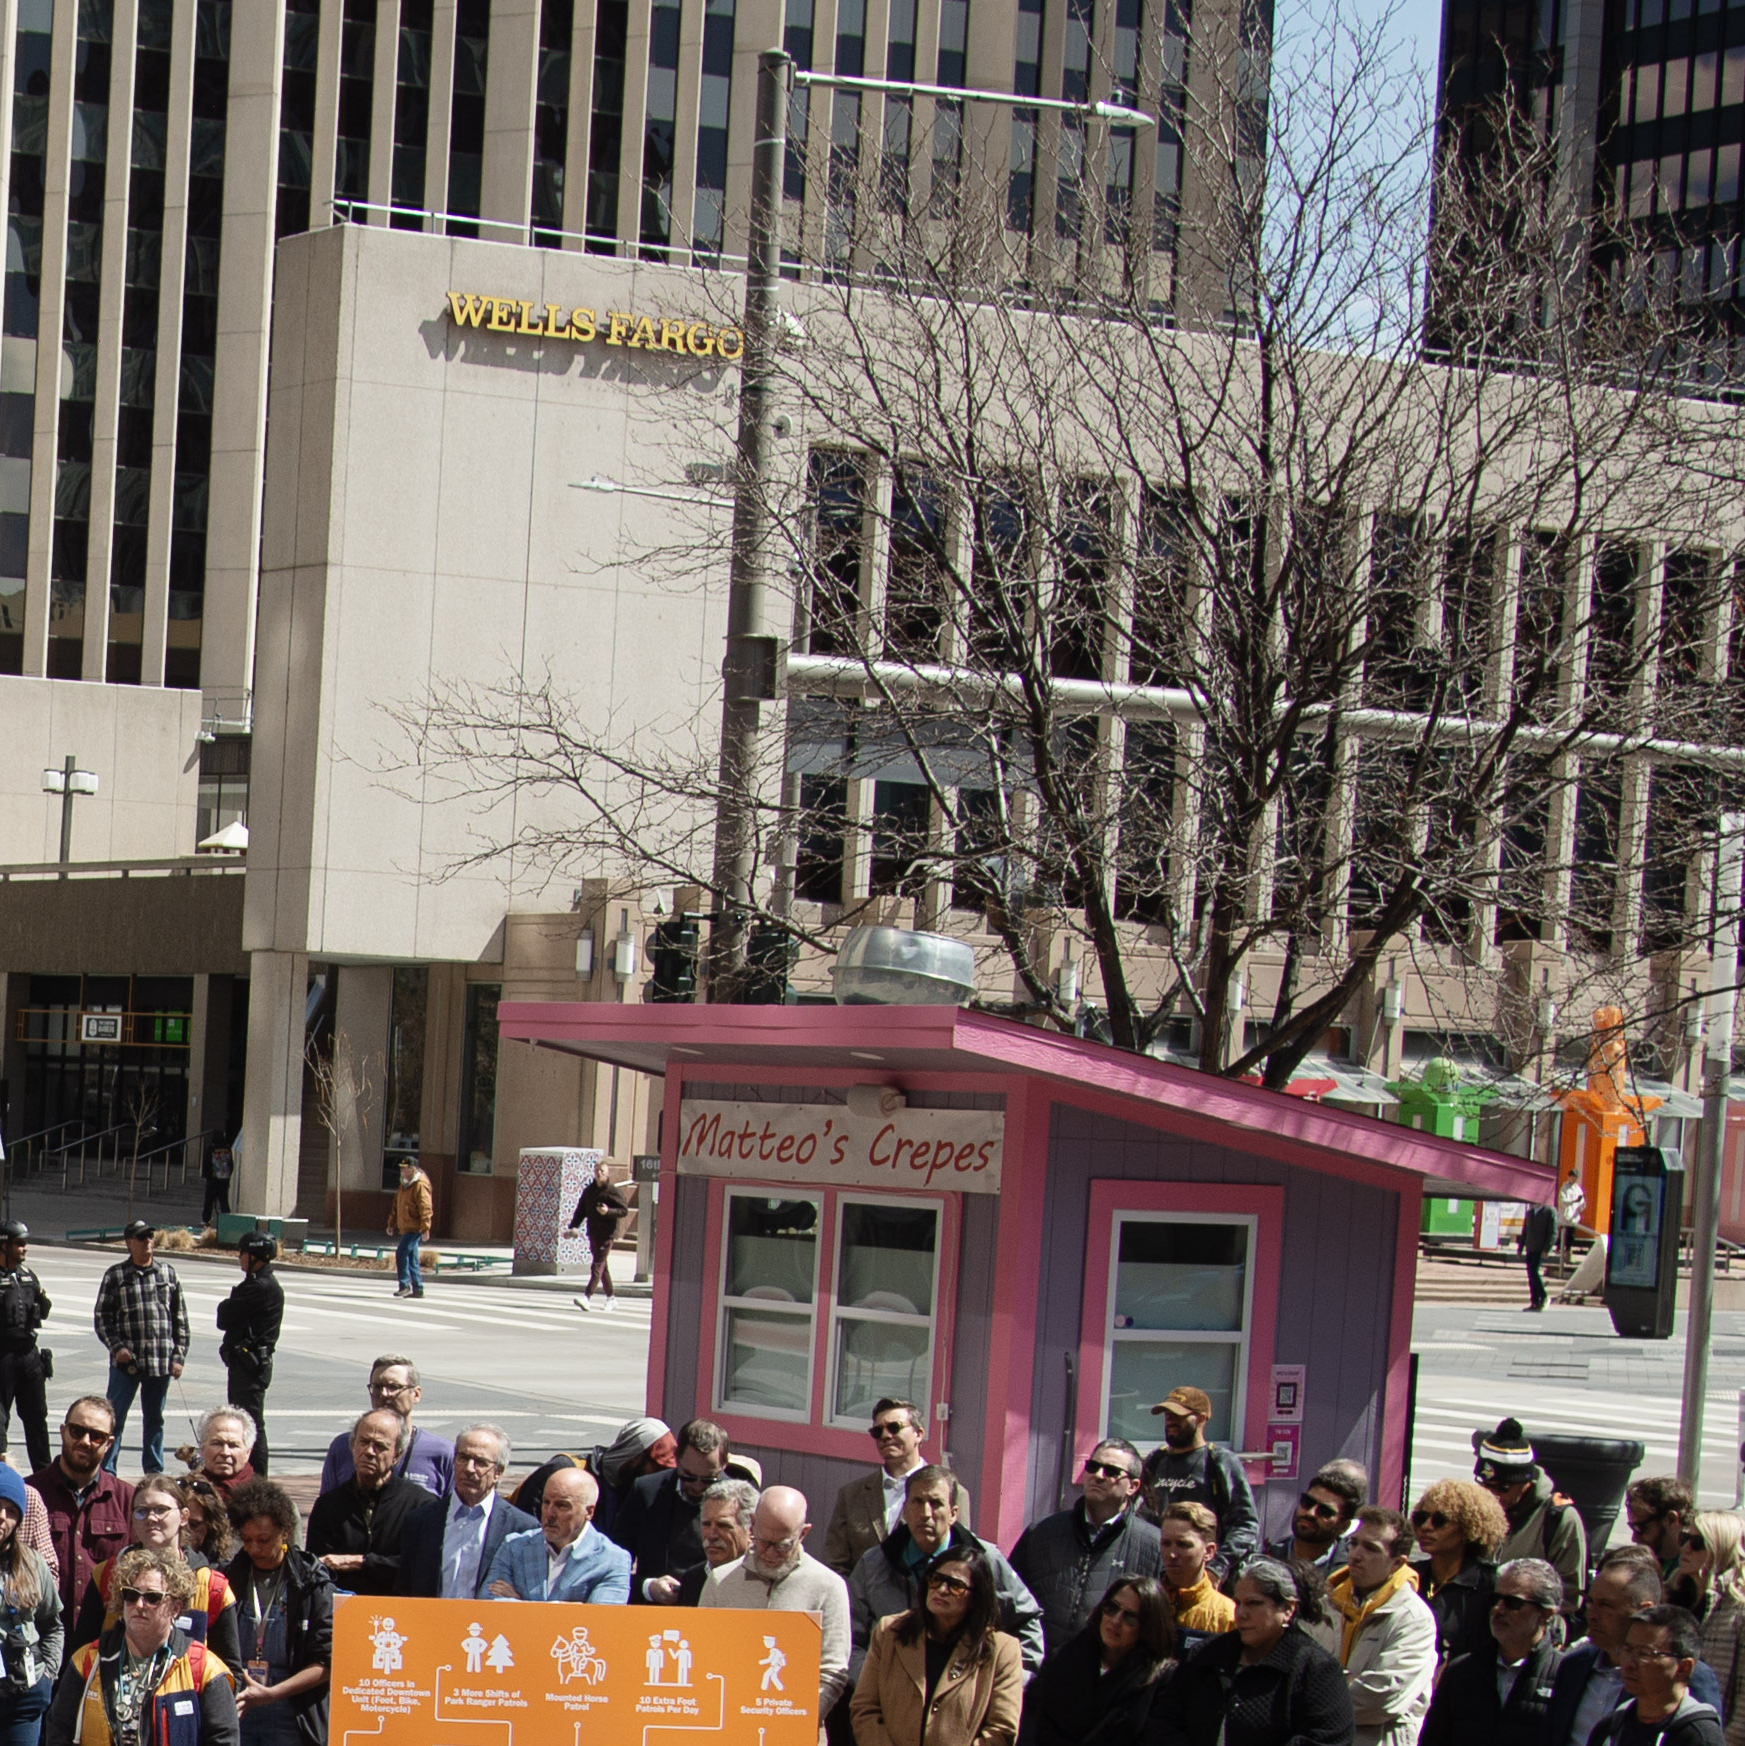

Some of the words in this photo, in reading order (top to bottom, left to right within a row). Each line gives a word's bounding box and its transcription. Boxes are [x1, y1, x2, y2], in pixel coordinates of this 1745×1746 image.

[447, 291, 596, 342] WELLS
[606, 310, 744, 360] FARGO
[681, 1112, 849, 1165] Matteo's
[868, 1123, 995, 1187] Crepes
[359, 1679, 370, 1687] 10
[372, 1679, 405, 1688] Officers
[407, 1680, 415, 1688] in
[342, 1686, 385, 1696] Dedicated
[387, 1688, 431, 1697] Downtown
[462, 1688, 483, 1697] More
[485, 1689, 509, 1698] Shifts
[510, 1690, 520, 1698] of
[351, 1695, 369, 1704] Unit
[444, 1696, 464, 1705] Park
[466, 1697, 496, 1707] Ranger
[498, 1698, 528, 1707] Patrols
[545, 1692, 583, 1702] Mounted
[584, 1694, 609, 1703] Horse
[639, 1696, 651, 1704] 10
[653, 1696, 675, 1705] Extra
[677, 1697, 696, 1706] Foot
[763, 1698, 793, 1707] Private
[360, 1704, 411, 1715] Motorcycle)
[564, 1702, 589, 1711] Patrol
[635, 1704, 665, 1713] Patrols
[667, 1705, 681, 1713] Per
[683, 1706, 700, 1716] Day
[740, 1706, 773, 1716] Security
[775, 1706, 808, 1716] Officers
